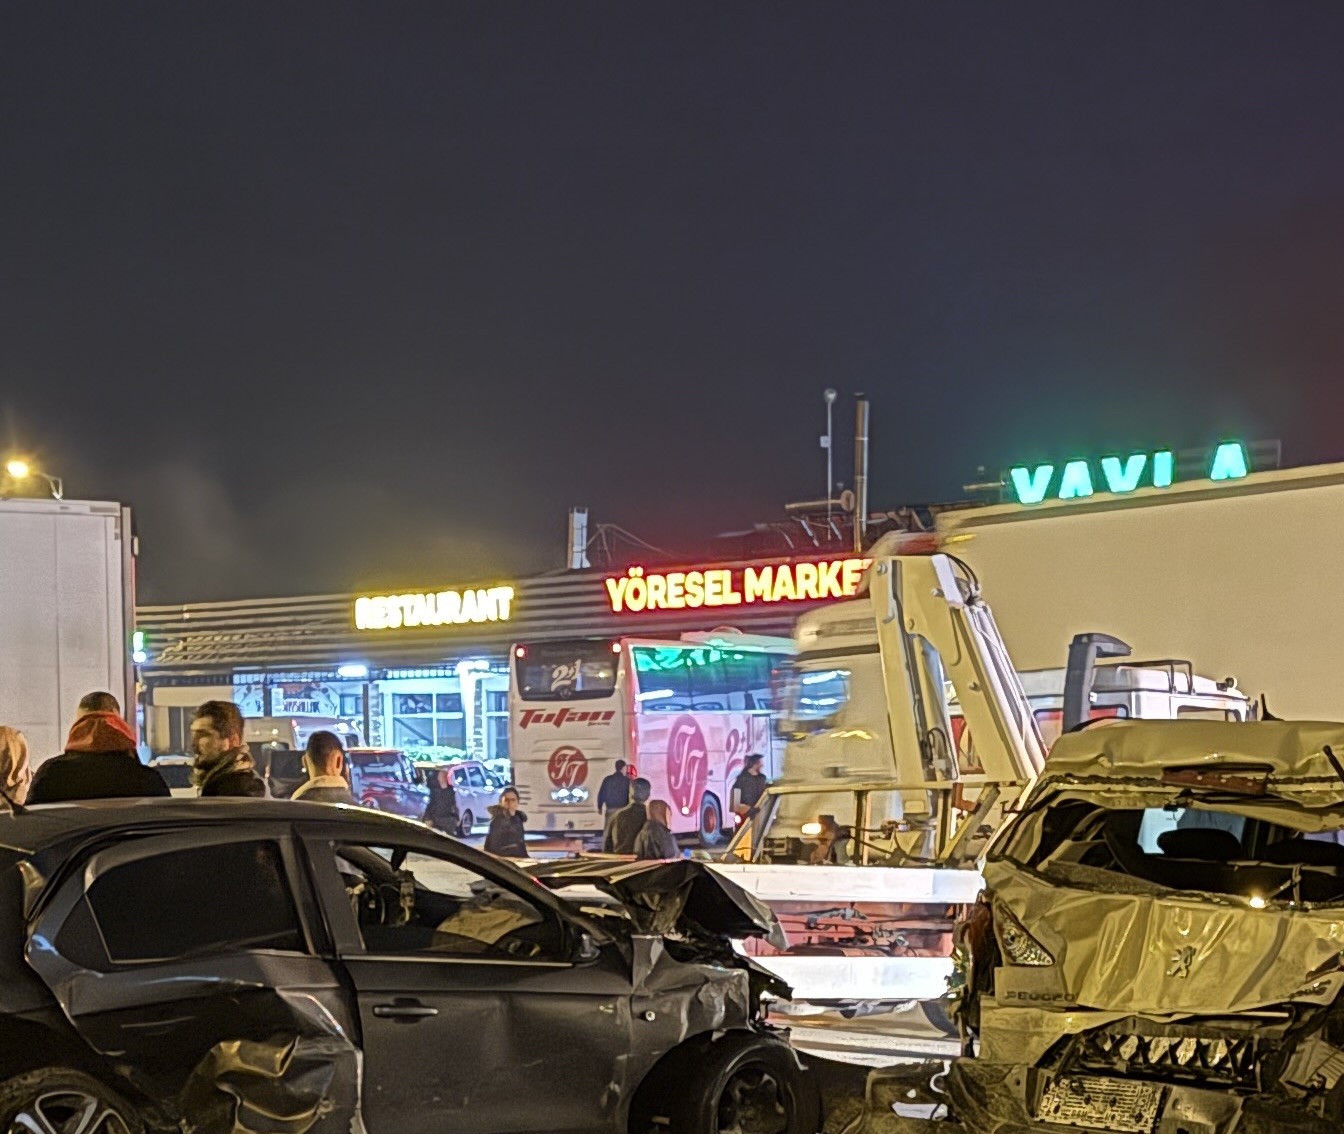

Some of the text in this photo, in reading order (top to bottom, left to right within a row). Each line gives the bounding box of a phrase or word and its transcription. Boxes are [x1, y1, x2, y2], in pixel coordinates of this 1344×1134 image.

[606, 566, 742, 612] YÖRESEL
[355, 586, 514, 629] RESTAURANT
[519, 707, 616, 729] Tufan
[1004, 990, 1077, 1002] PEUGEO
